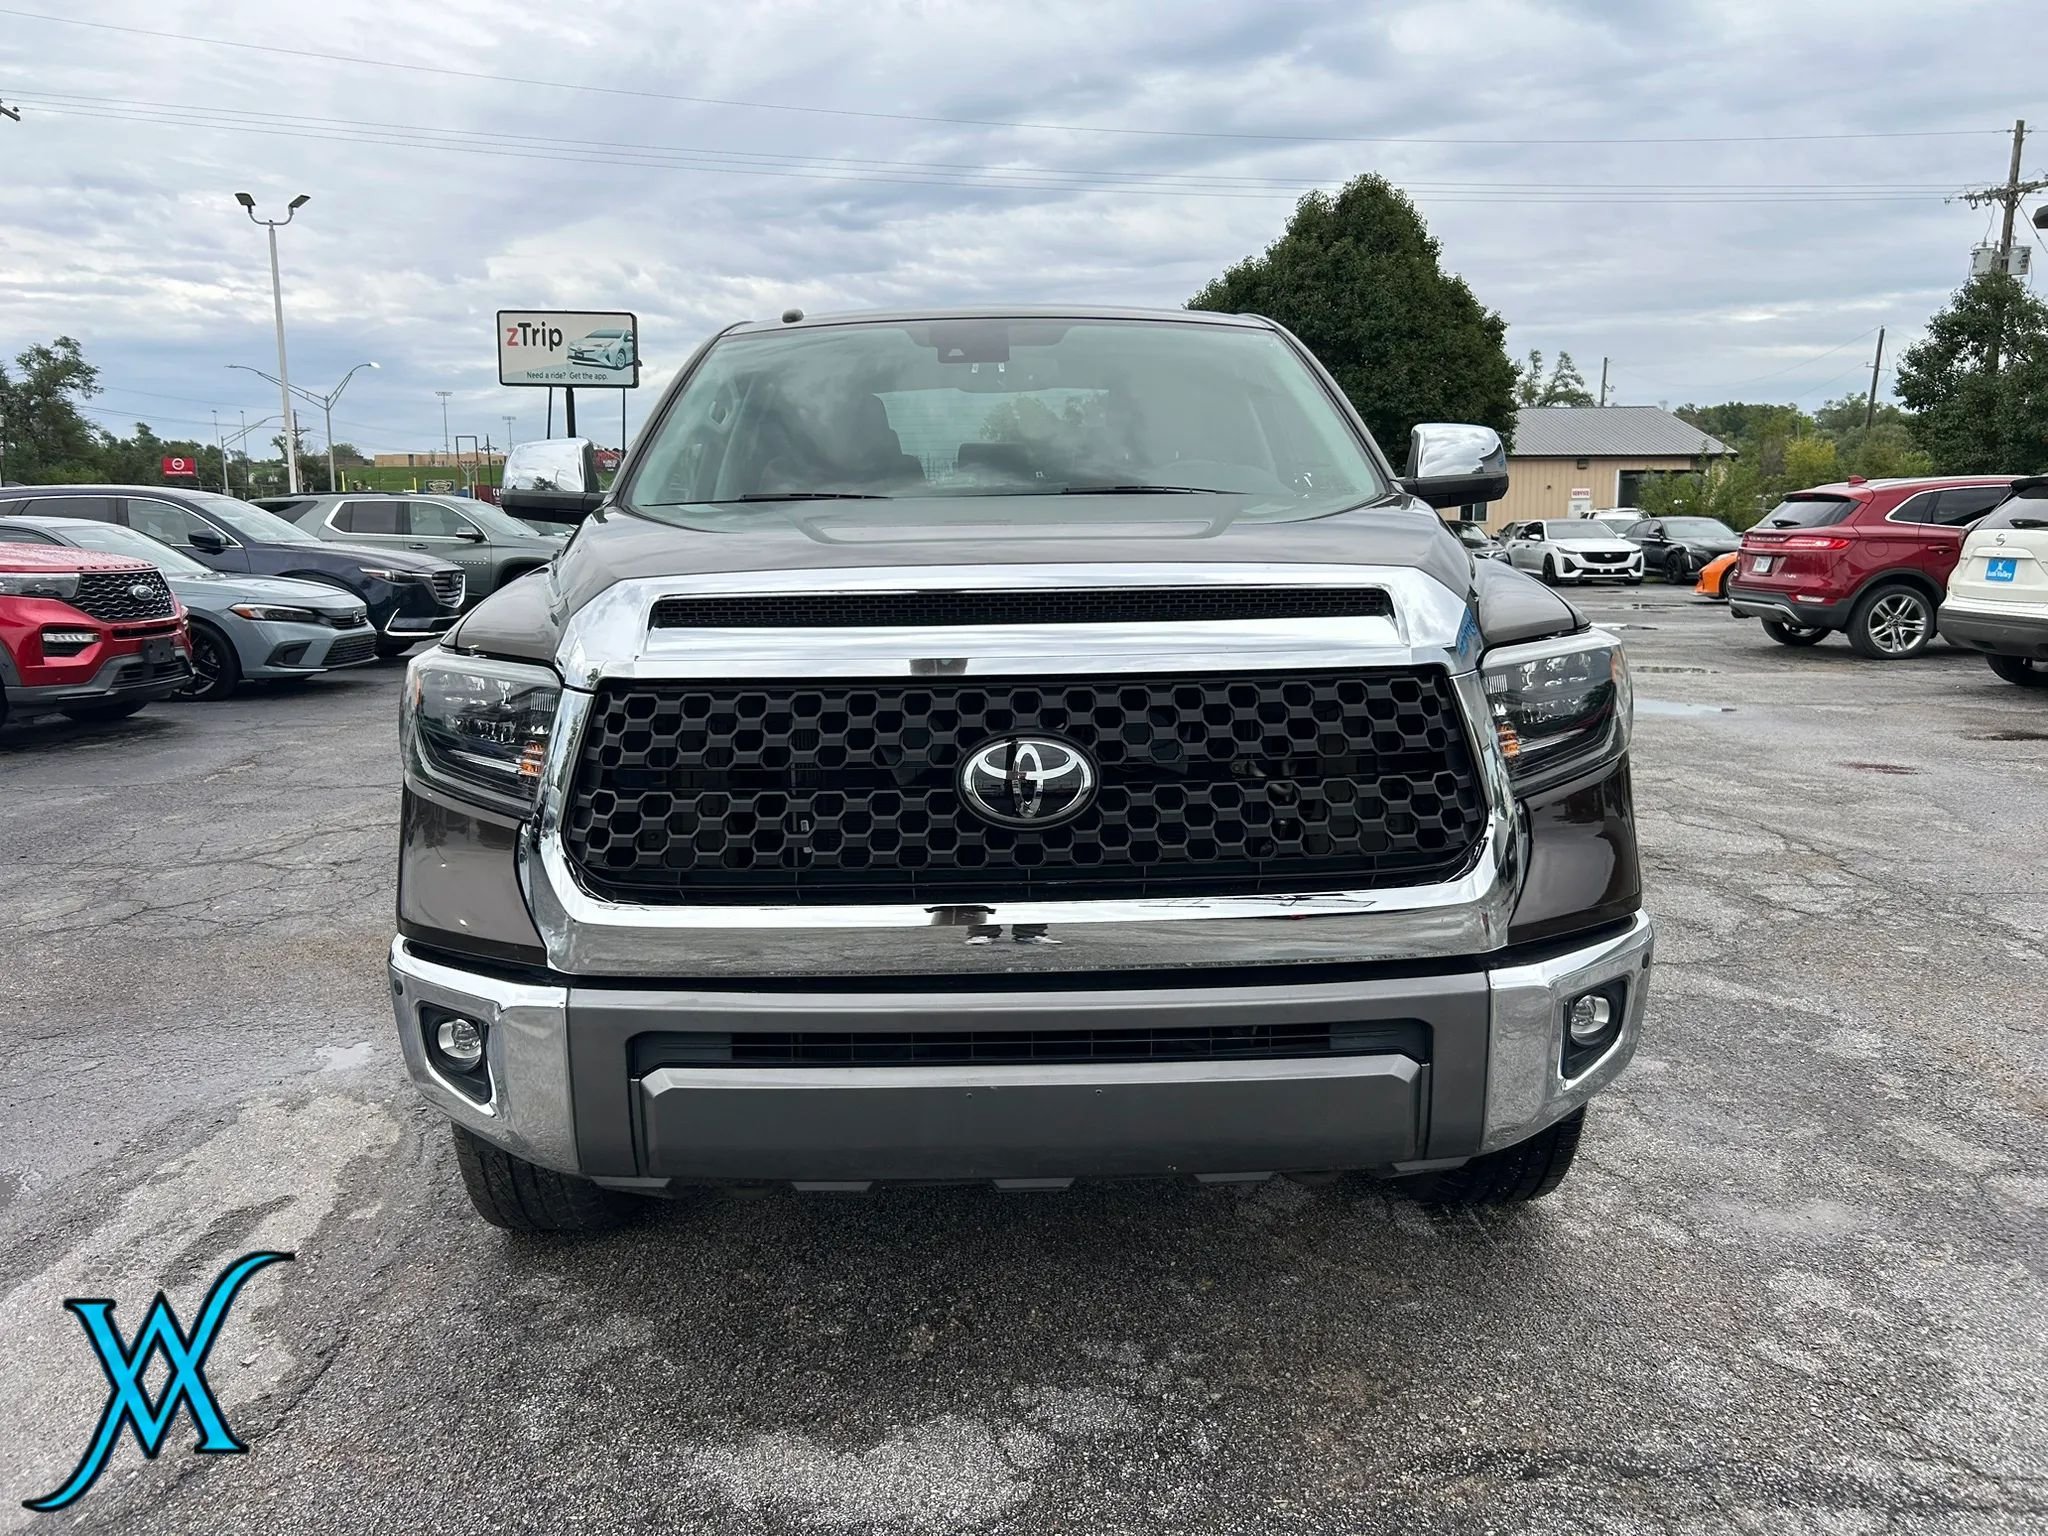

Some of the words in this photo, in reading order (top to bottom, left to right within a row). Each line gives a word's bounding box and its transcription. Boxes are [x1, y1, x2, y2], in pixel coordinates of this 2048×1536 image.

[506, 321, 563, 352] zTrip
[526, 371, 544, 379] Need
[550, 371, 567, 379] ride?
[569, 372, 582, 380] Get
[582, 372, 594, 380] the
[594, 373, 608, 381] app.
